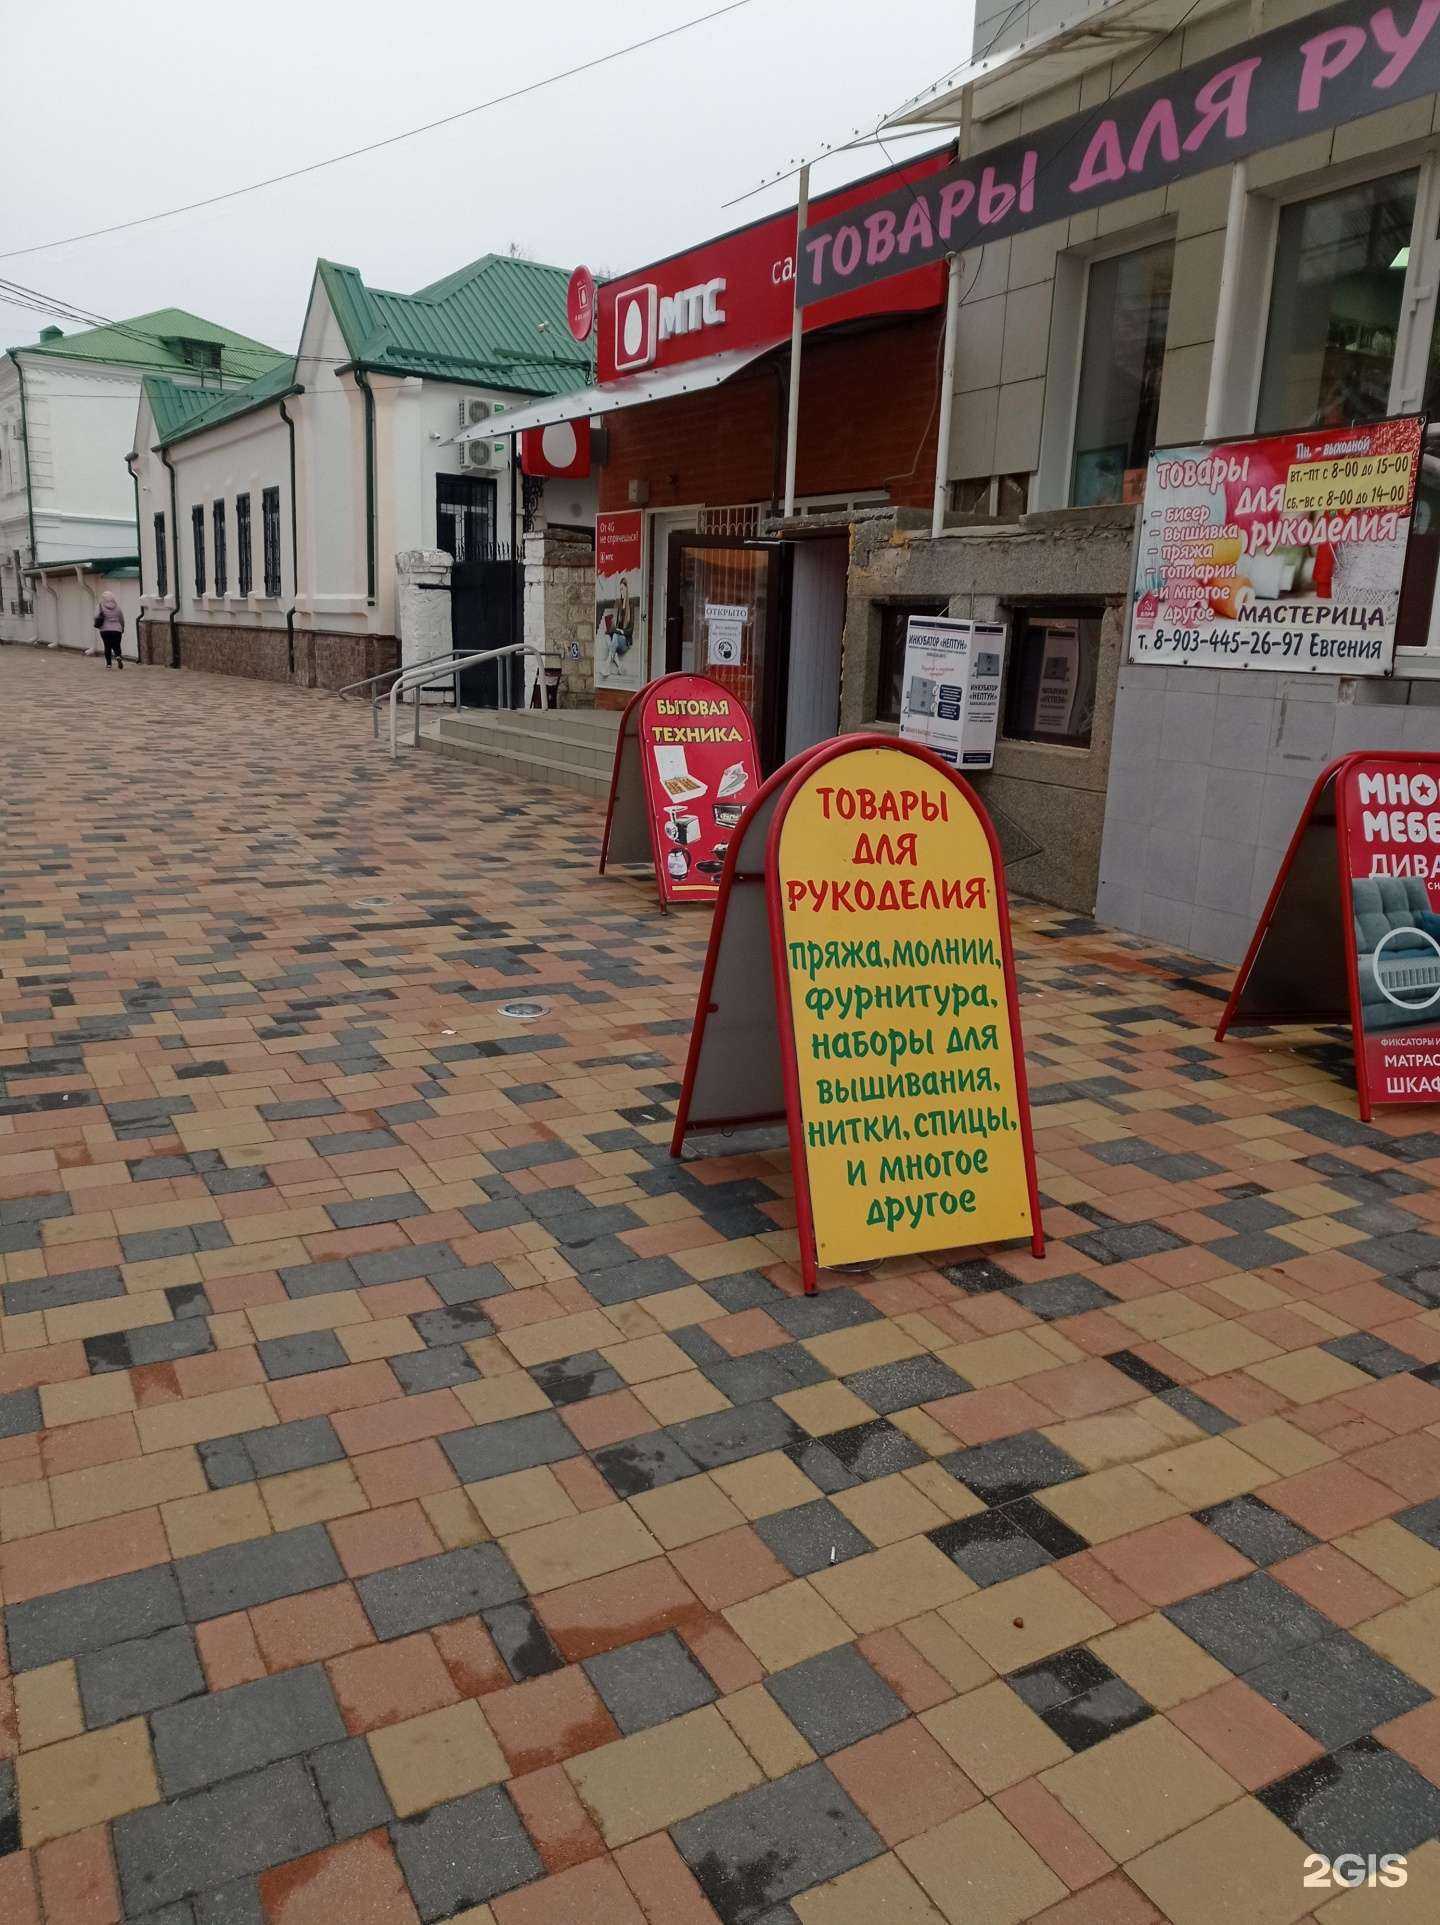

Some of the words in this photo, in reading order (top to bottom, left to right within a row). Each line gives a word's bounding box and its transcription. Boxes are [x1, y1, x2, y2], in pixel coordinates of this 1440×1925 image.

[806, 151, 1037, 285] ТОВАРЫ
[1069, 57, 1261, 193] ДЛЯ
[772, 256, 798, 284] са
[658, 277, 727, 341] МТС
[1331, 461, 1359, 479] 8-00
[1376, 455, 1409, 474] 15-00
[1326, 489, 1353, 506] 8-00
[1371, 484, 1404, 503] 14-00
[1165, 504, 1210, 524] бисер
[1163, 523, 1239, 541] вышивка
[1249, 511, 1398, 556] рукоделия
[1160, 543, 1214, 563] пряжа
[1159, 563, 1237, 584] топиарии
[1173, 585, 1231, 600] многое
[705, 607, 747, 617] ОТКРЫТО
[1163, 604, 1216, 626] другое
[1237, 604, 1386, 630] МАСТЕРИЦА
[908, 633, 939, 648] ИНКУБАТОР
[1153, 628, 1304, 656] 8-903-445-26-97
[1309, 632, 1383, 660] Евгения
[656, 699, 730, 716] БЫТОВАЯ
[651, 726, 743, 743] ТЕХНИКА
[1358, 772, 1440, 806] МНО
[816, 787, 949, 822] ТОВАРЫ
[851, 832, 918, 866] ДЛЯ
[786, 877, 987, 912] РУКОДЕЛИЯ
[805, 983, 998, 1020] фурнитура,
[811, 1027, 935, 1067] наборы
[1380, 1037, 1435, 1047] ФИКСАТОРЫ
[816, 1066, 1001, 1105] вышивания,
[879, 1148, 989, 1183] многое
[866, 1188, 977, 1232] другое
